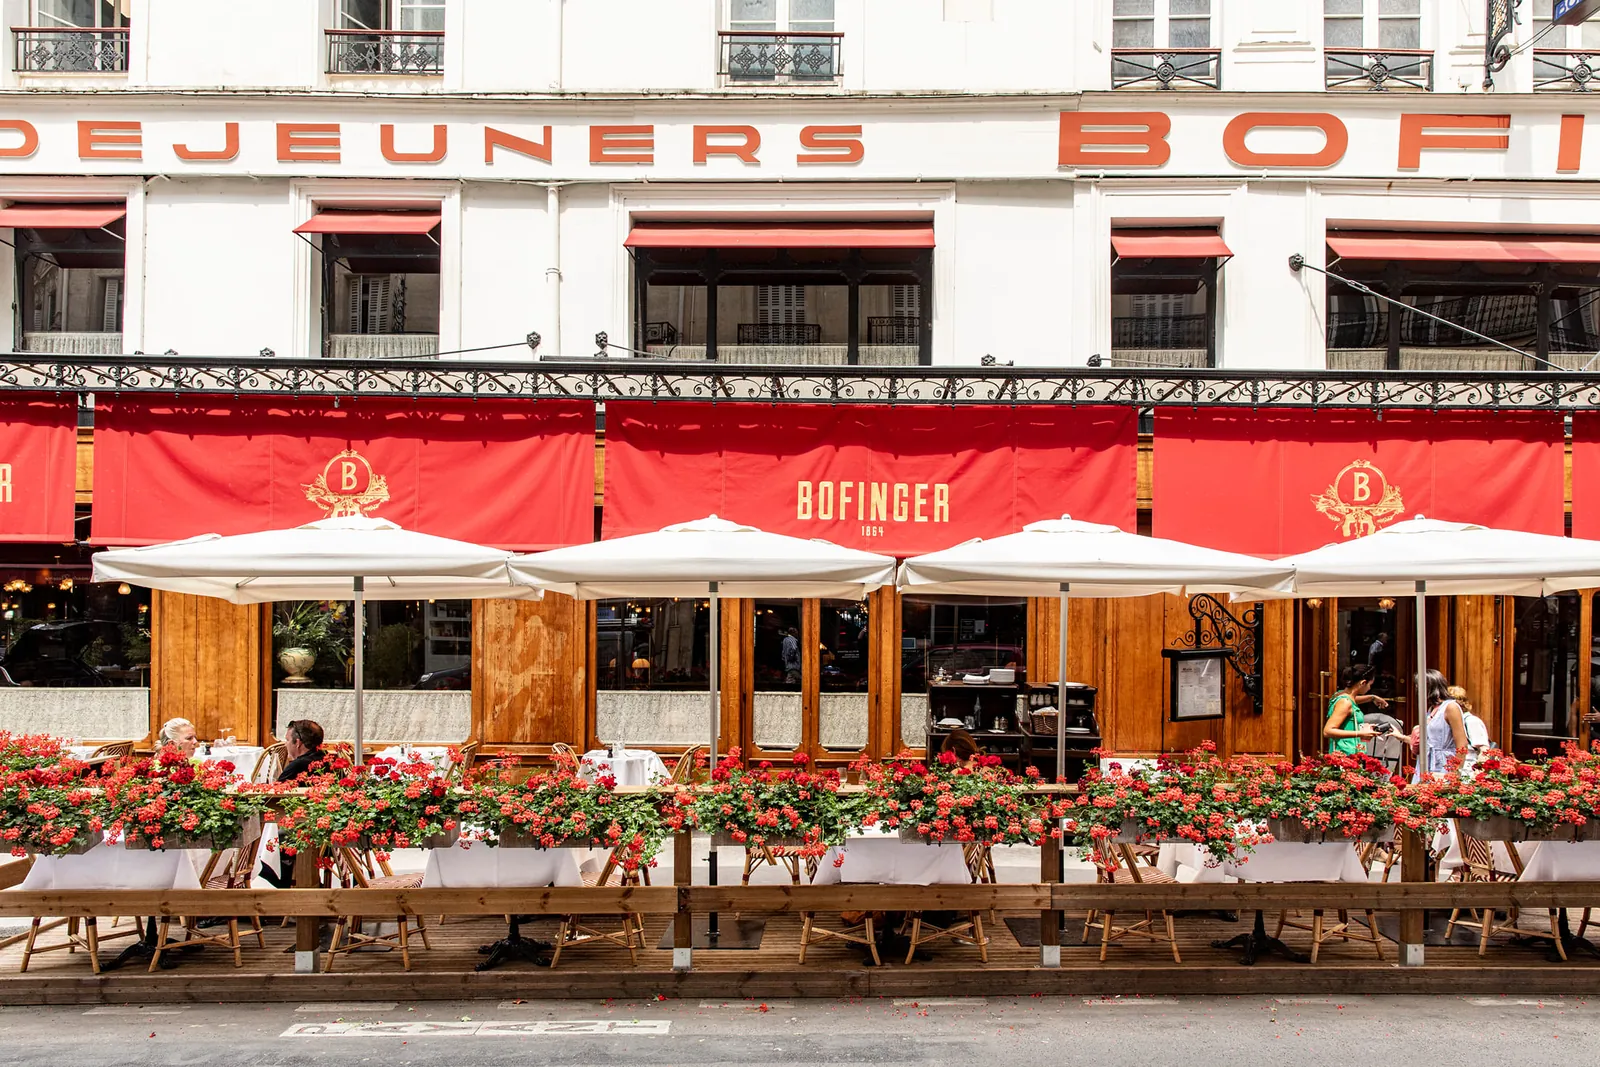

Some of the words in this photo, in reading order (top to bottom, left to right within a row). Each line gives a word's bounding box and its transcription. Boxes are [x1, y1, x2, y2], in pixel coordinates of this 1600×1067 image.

[0, 119, 865, 164] DEJEUNERS
[1058, 111, 1586, 173] BOFI
[341, 461, 358, 491] B
[1353, 472, 1371, 501] B
[797, 480, 950, 523] BOFINGER
[861, 525, 884, 537] 1864
[293, 1021, 660, 1035] PAYANT
